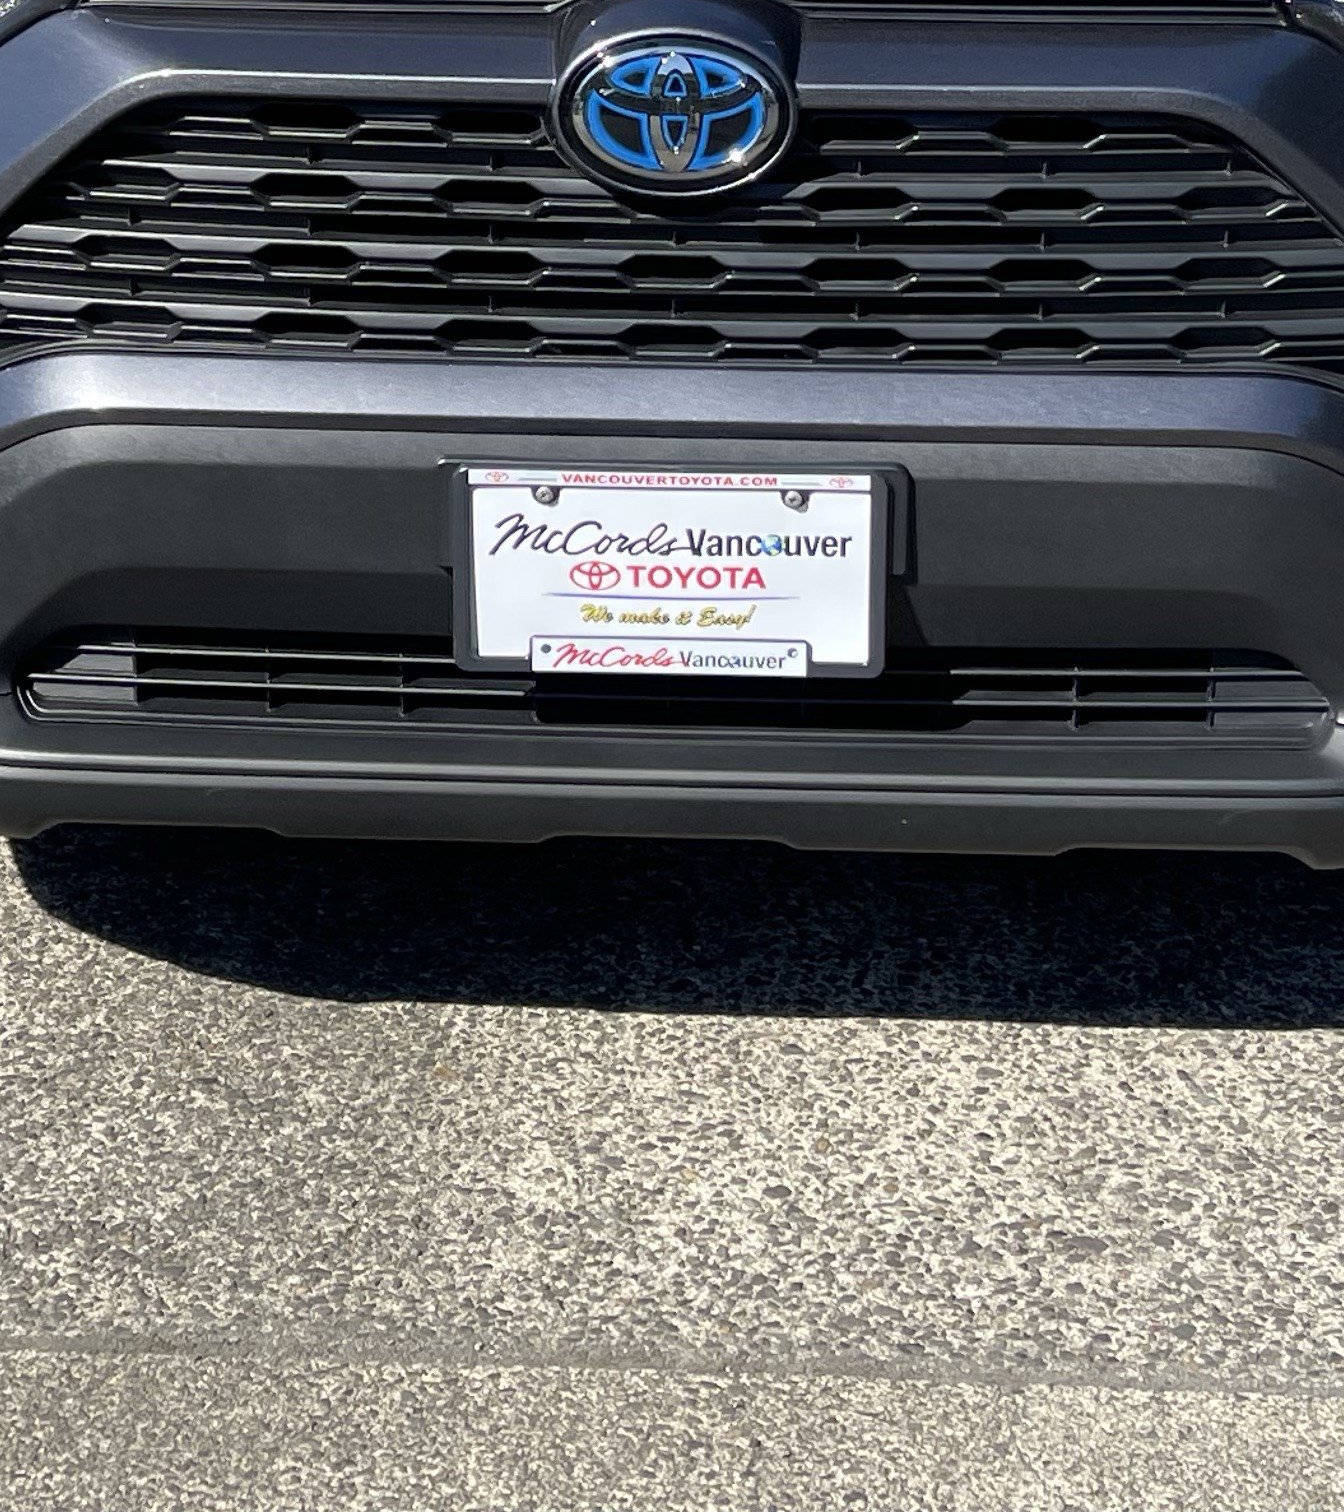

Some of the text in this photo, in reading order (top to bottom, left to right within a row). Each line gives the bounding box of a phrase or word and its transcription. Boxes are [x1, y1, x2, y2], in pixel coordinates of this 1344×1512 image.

[561, 473, 778, 487] VANCOUVERTOYOTA.COM
[685, 528, 853, 558] Vancouver
[627, 566, 767, 589] TOYOTA
[580, 604, 613, 623] We
[618, 607, 670, 625] make
[697, 604, 757, 630] Easy!
[679, 651, 786, 670] Vancouver
